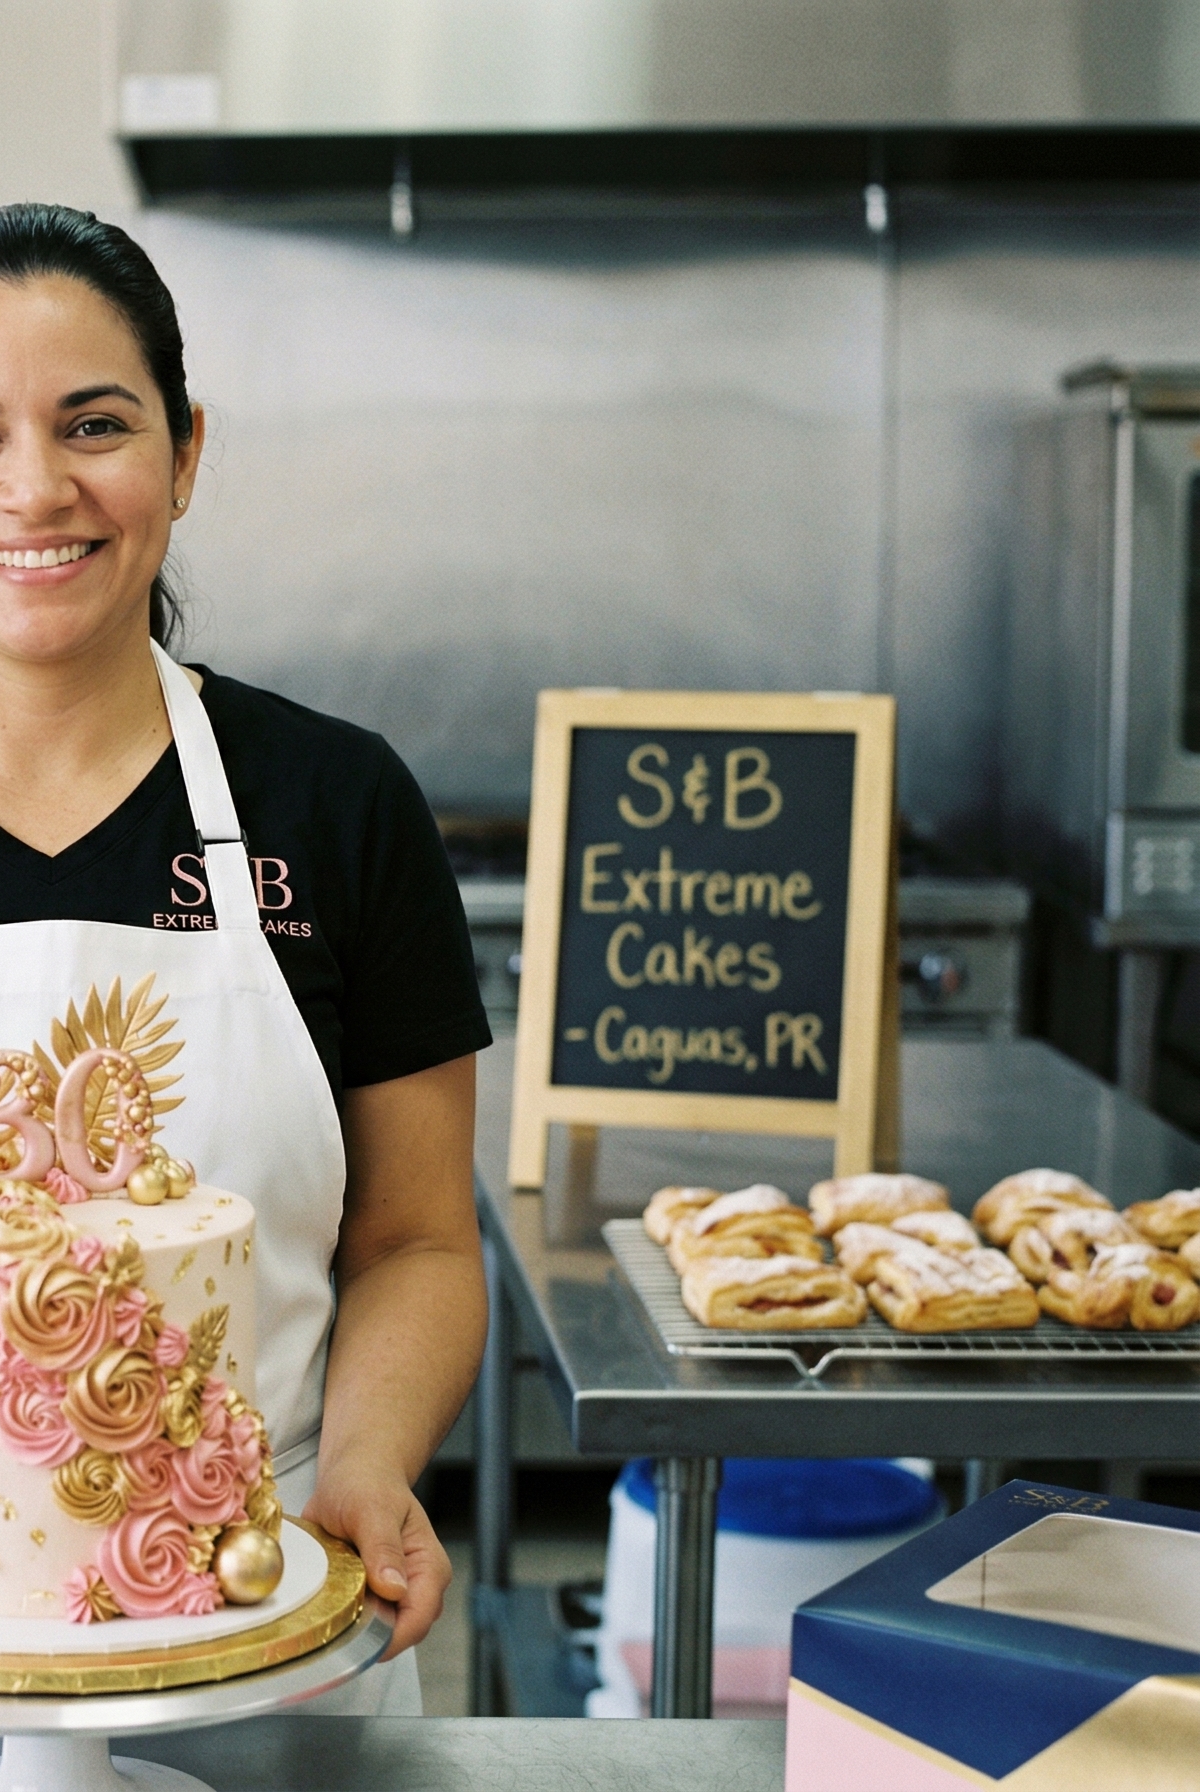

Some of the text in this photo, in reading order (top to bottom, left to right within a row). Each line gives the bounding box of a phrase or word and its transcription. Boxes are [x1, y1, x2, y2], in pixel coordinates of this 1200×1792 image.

[617, 743, 783, 830] S&B
[171, 853, 293, 910] SB
[580, 842, 822, 920] Extreme
[153, 913, 219, 930] EXTRE
[606, 922, 782, 992] Cakes
[765, 1012, 828, 1076] PR
